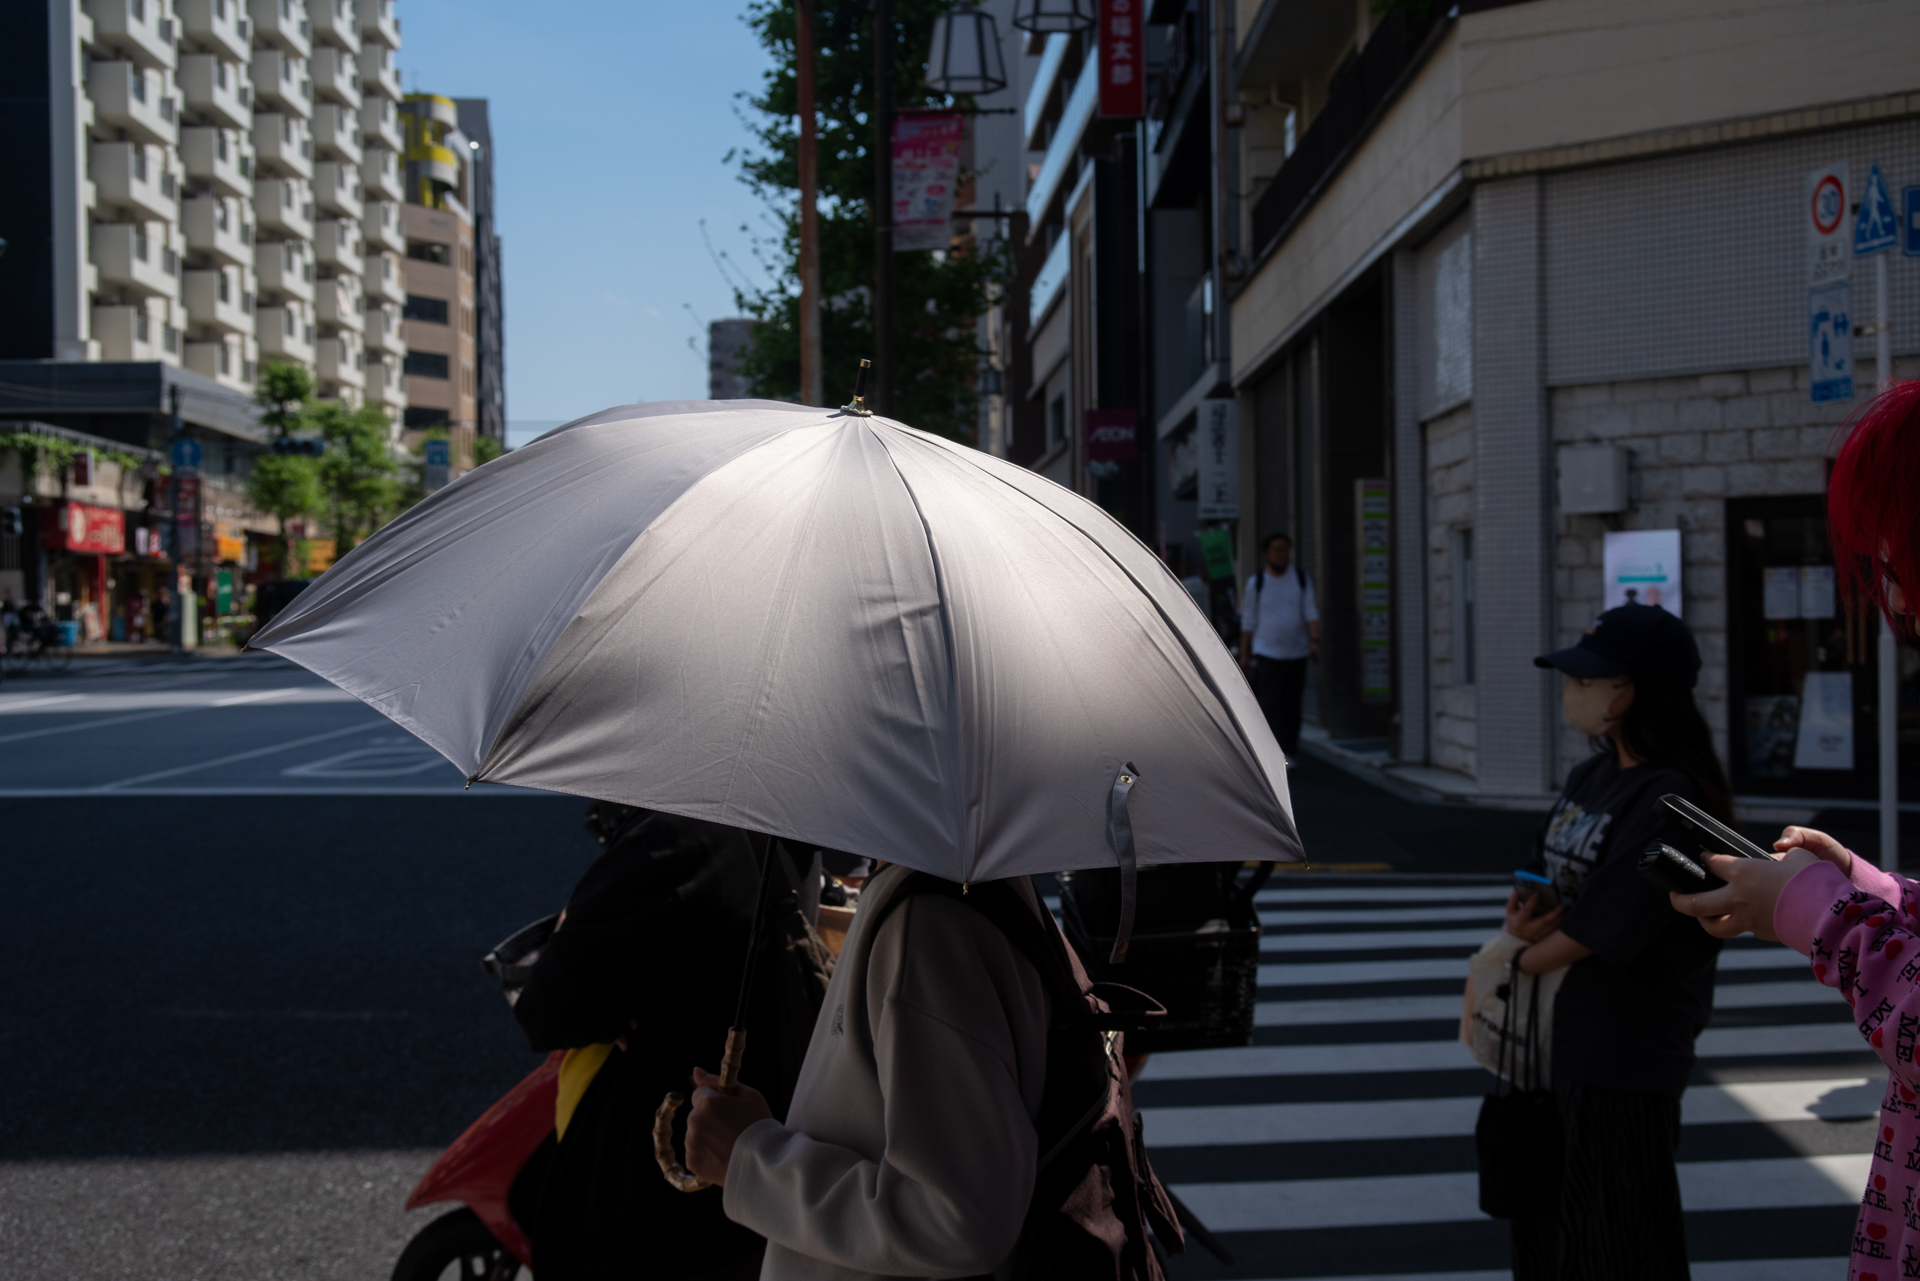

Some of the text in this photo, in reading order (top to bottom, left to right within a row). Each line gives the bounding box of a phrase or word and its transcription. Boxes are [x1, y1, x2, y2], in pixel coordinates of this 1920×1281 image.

[1819, 190, 1838, 219] 30
[1089, 425, 1135, 443] AEON
[1859, 997, 1896, 1042] ME
[1896, 1012, 1918, 1063] ME
[1906, 1186, 1914, 1203] I
[1853, 1236, 1885, 1259] ME
[1906, 1244, 1917, 1261] I
